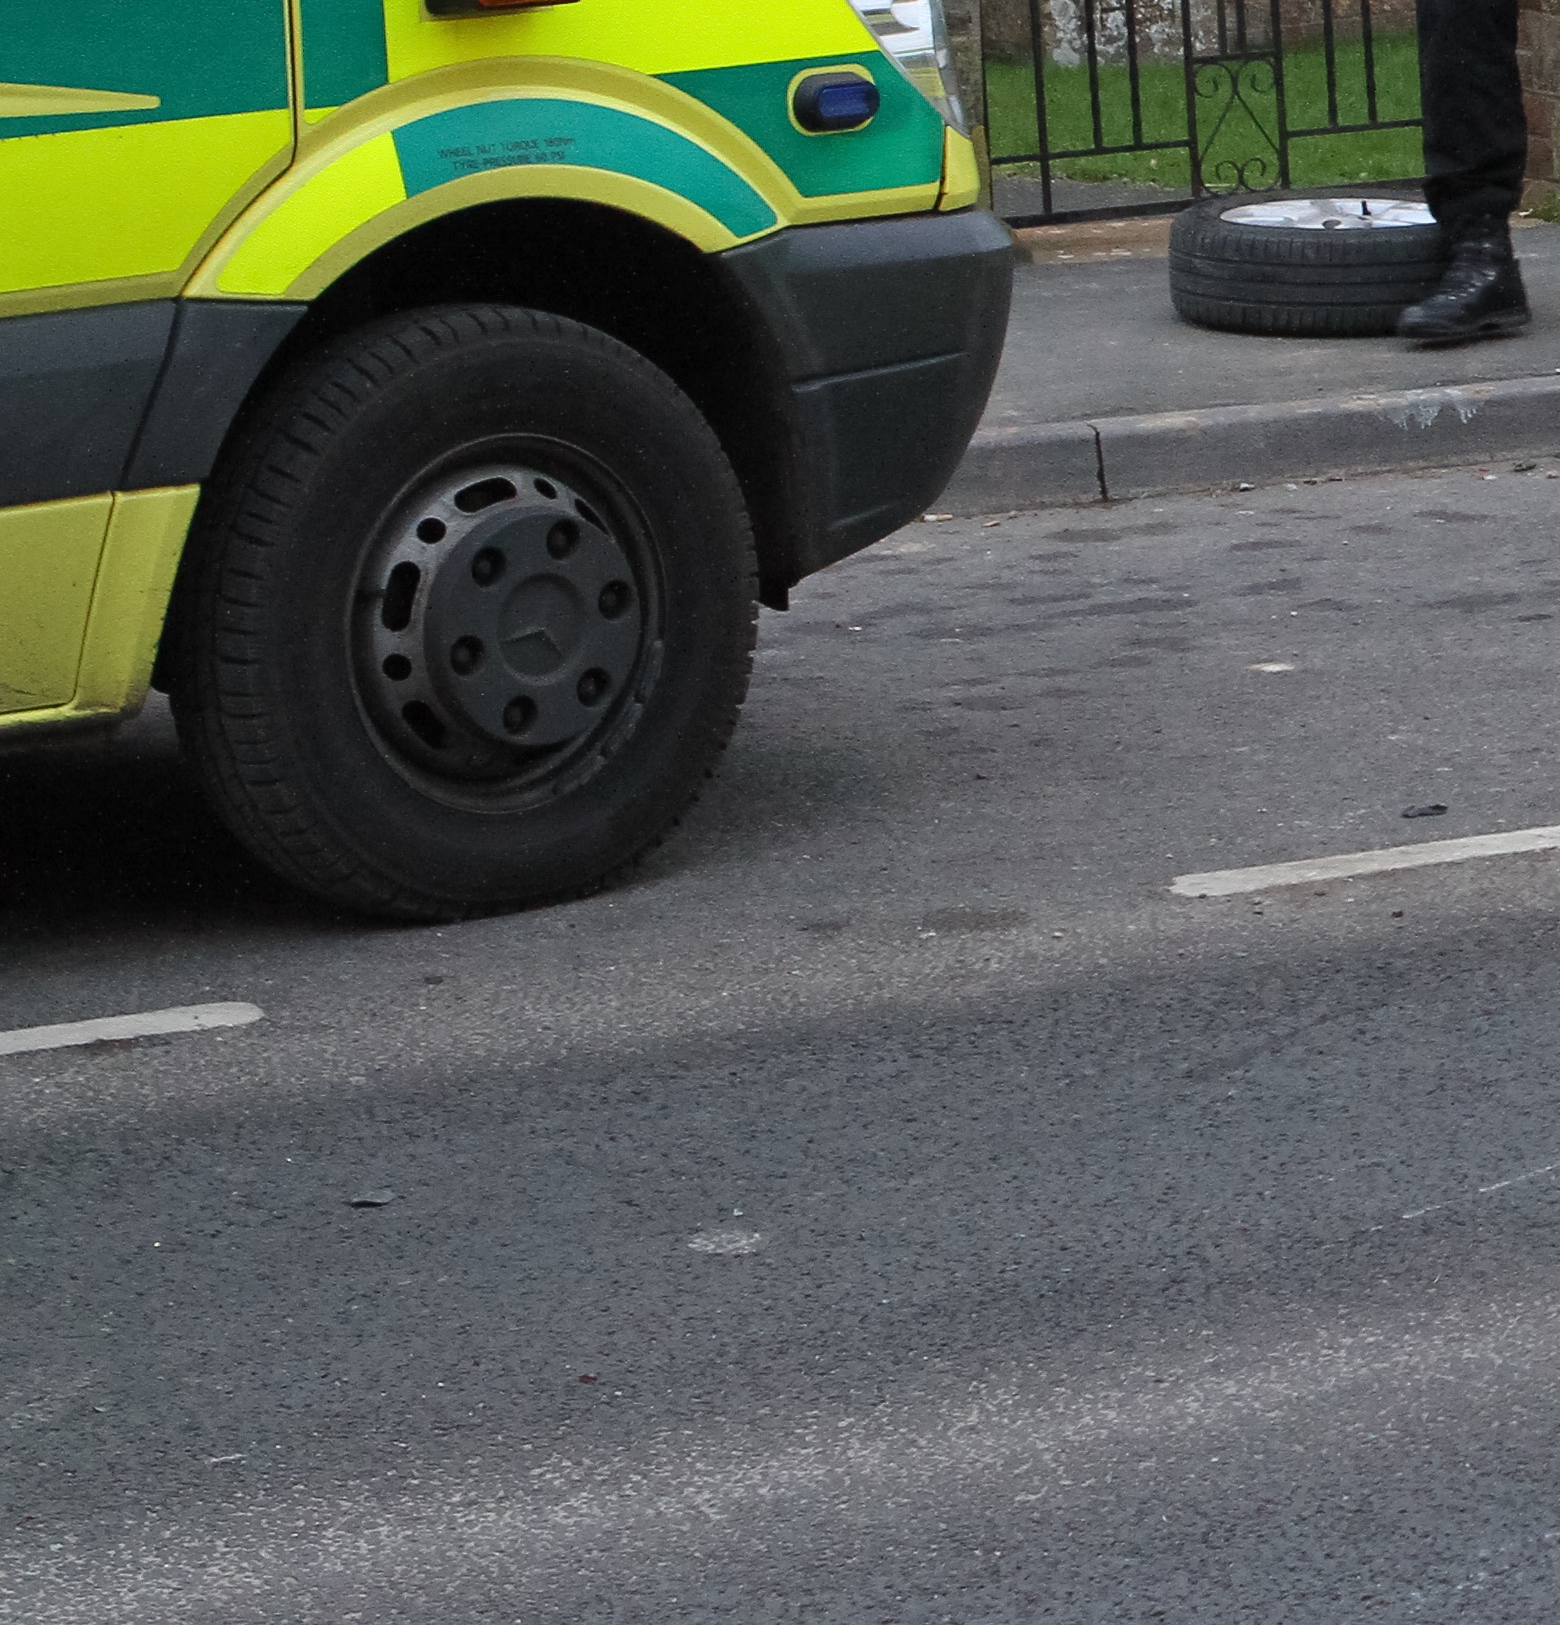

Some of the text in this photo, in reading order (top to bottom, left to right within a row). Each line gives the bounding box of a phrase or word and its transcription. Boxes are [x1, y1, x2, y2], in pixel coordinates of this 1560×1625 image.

[438, 145, 474, 159] WHEEL
[475, 143, 495, 155] NUT
[500, 138, 540, 152] TORQUE
[481, 153, 531, 168] PRESSURE
